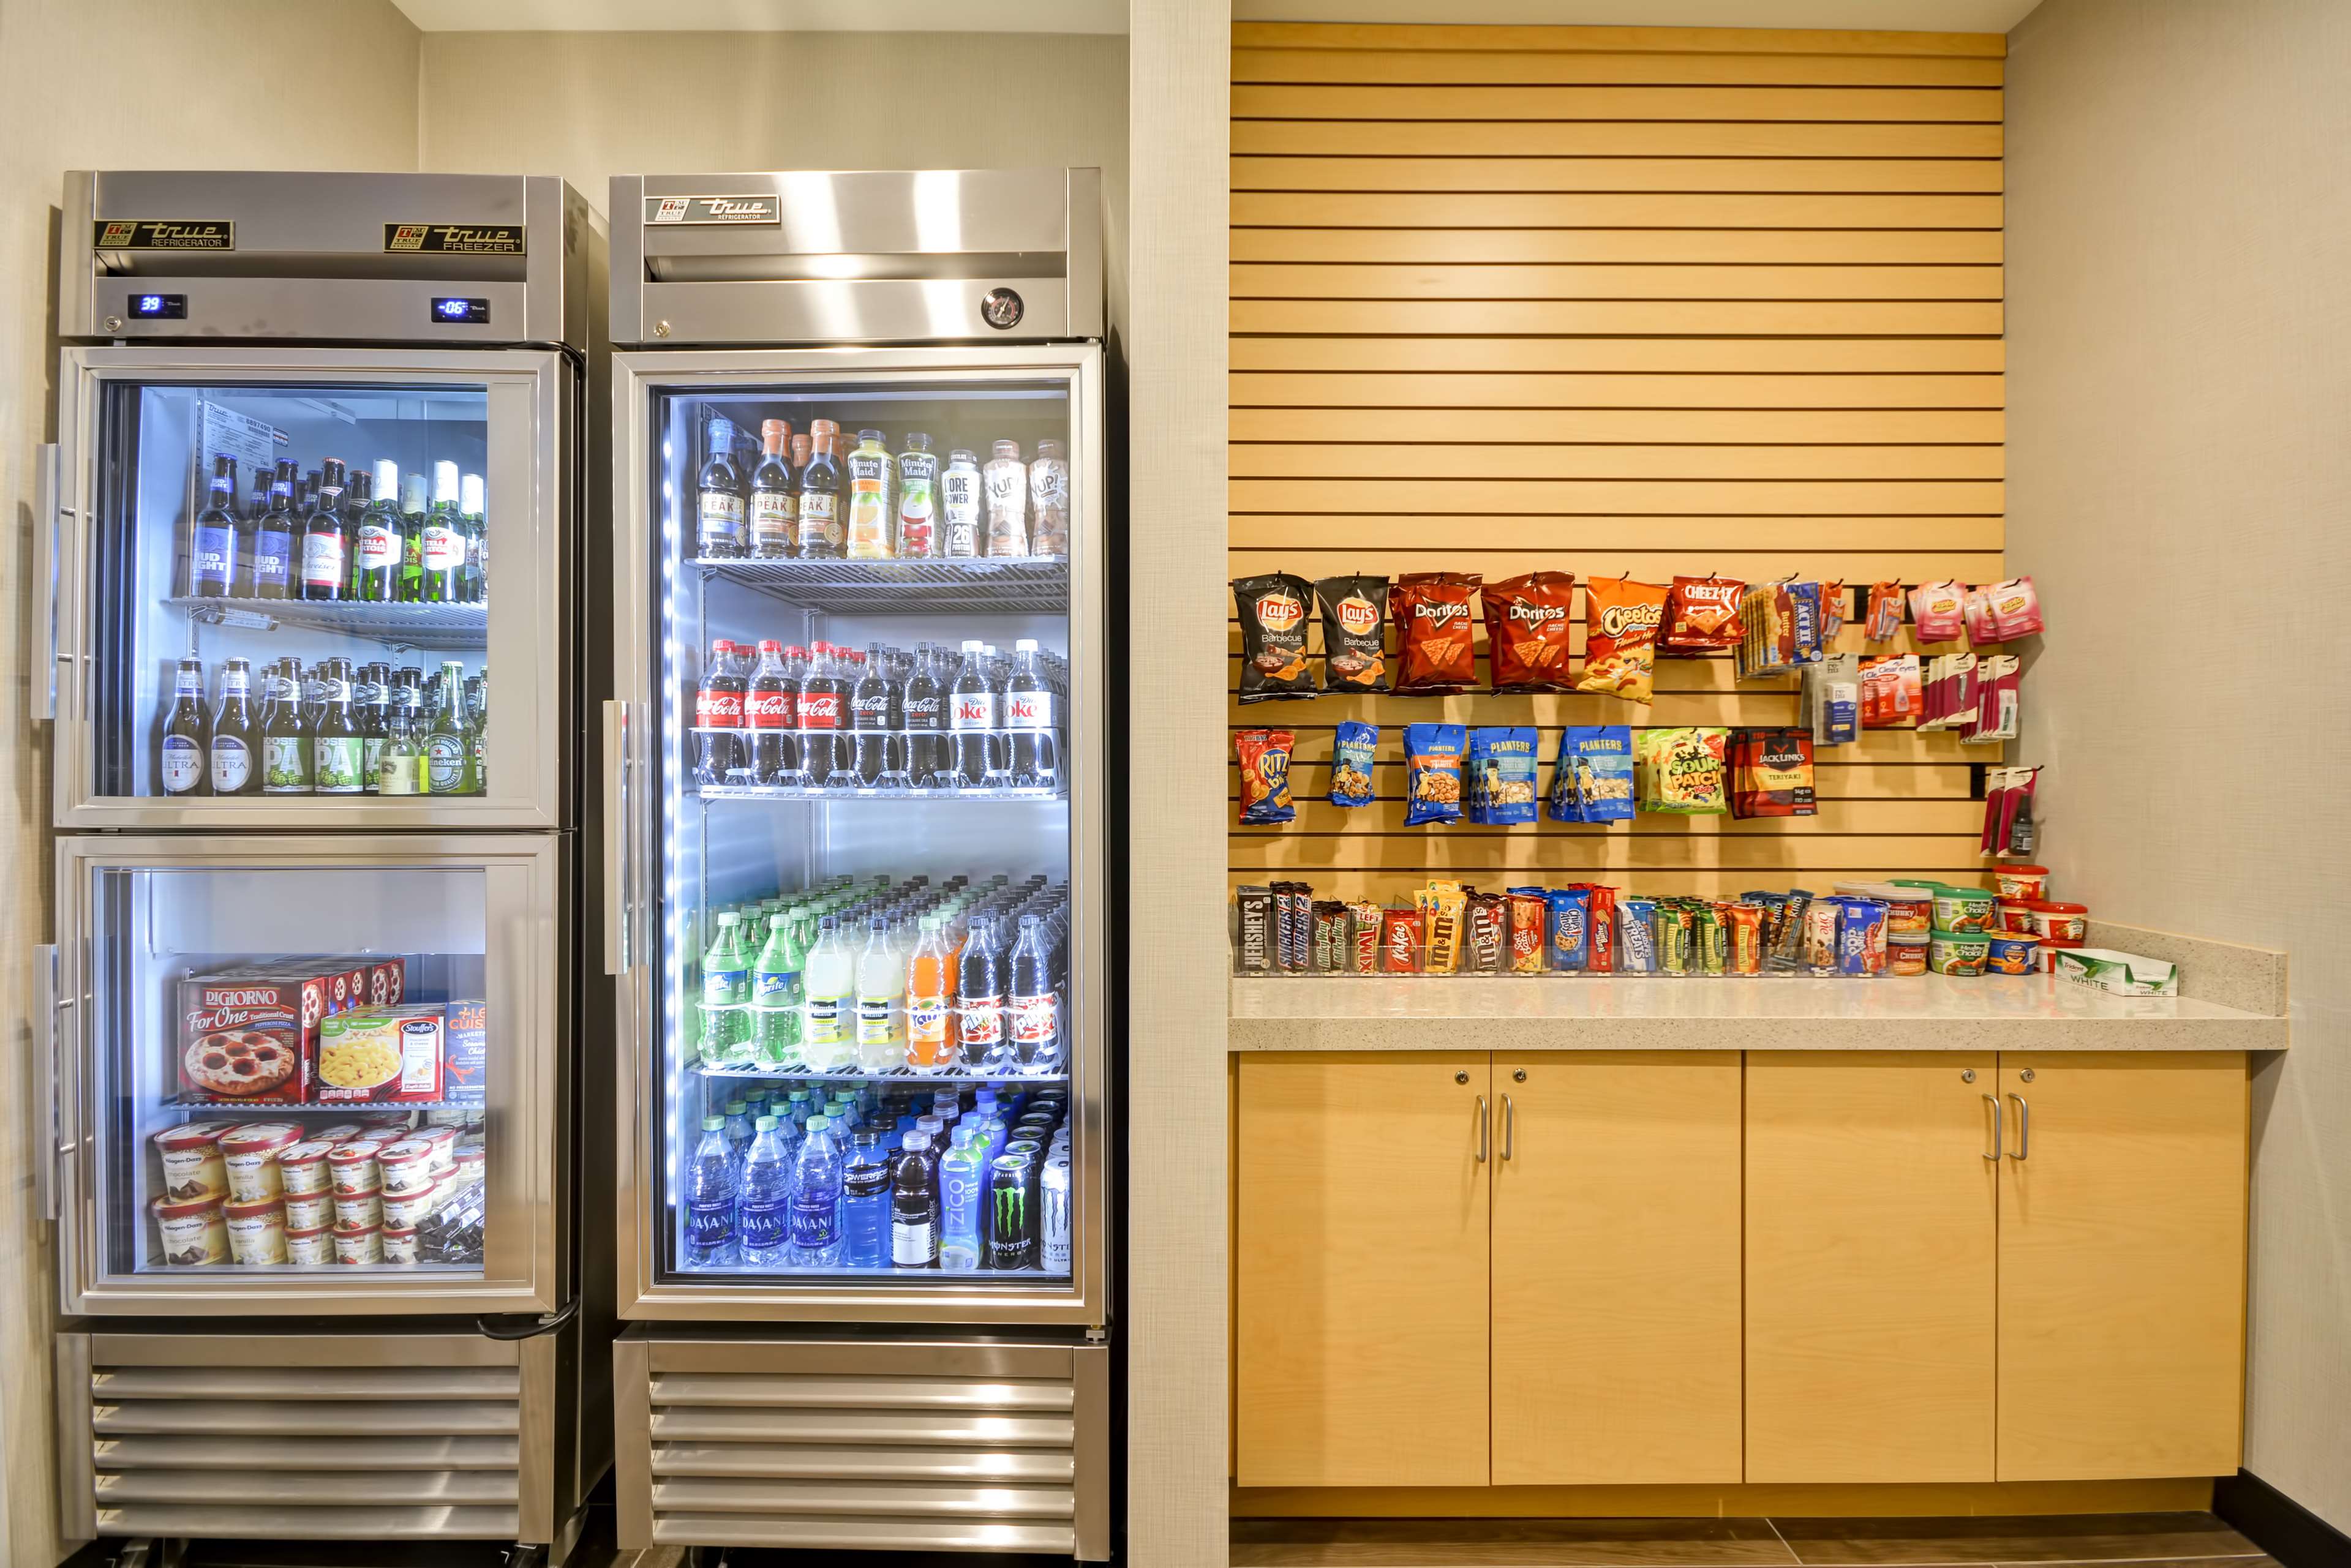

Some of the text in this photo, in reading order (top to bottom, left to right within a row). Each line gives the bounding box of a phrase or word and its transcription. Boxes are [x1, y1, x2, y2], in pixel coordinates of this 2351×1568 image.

[141, 297, 159, 310] 39
[953, 525, 970, 544] 26
[1262, 601, 1298, 620] Lay's
[1342, 604, 1374, 624] Lay's
[1415, 604, 1468, 617] Doritos
[1510, 606, 1565, 620] Doritos
[1603, 605, 1661, 635] Cheetos
[1781, 611, 1789, 637] Butter
[1344, 637, 1379, 646] Barbecue
[1642, 631, 1654, 640] Ho
[696, 696, 743, 715] Coca-Cola
[745, 696, 791, 715] Coca-Cola
[797, 697, 841, 716] oca-Cola
[851, 696, 890, 711] Coca-Cola
[902, 697, 941, 712] Coca-Cola
[1491, 741, 1530, 754] PLANTERS
[1579, 739, 1622, 752] PLANTERS
[1260, 754, 1289, 778] RITZ
[1671, 756, 1720, 774] SOUR
[1759, 754, 1780, 763] JACK
[1671, 772, 1720, 789] PATCH
[1695, 786, 1715, 794] Kids
[1774, 902, 1783, 924] KIND
[1791, 896, 1803, 918] KIND
[1568, 909, 1581, 931] Chips
[1818, 912, 1829, 935] One
[1244, 901, 1263, 966] HERSHEY'S
[1279, 910, 1293, 969] SNICKERS
[1294, 910, 1309, 966] SNICKERS
[1514, 932, 1524, 951] Soft
[1521, 929, 1532, 955] Batch
[1623, 922, 1646, 959] TREATS
[1358, 925, 1377, 973] TWIX
[2064, 962, 2083, 971] Trident
[758, 979, 784, 997] Sprite
[2071, 974, 2110, 991] WHITE
[187, 1007, 248, 1032] For One
[279, 1011, 295, 1020] Crust
[450, 1019, 484, 1030] CUIS
[405, 1023, 434, 1033] Stouffer's
[949, 1179, 965, 1225] ZICO
[690, 1212, 733, 1232] DASANI
[743, 1214, 784, 1232] DASANI
[792, 1215, 832, 1232] DASANI
[989, 1237, 1031, 1251] MONSTER
